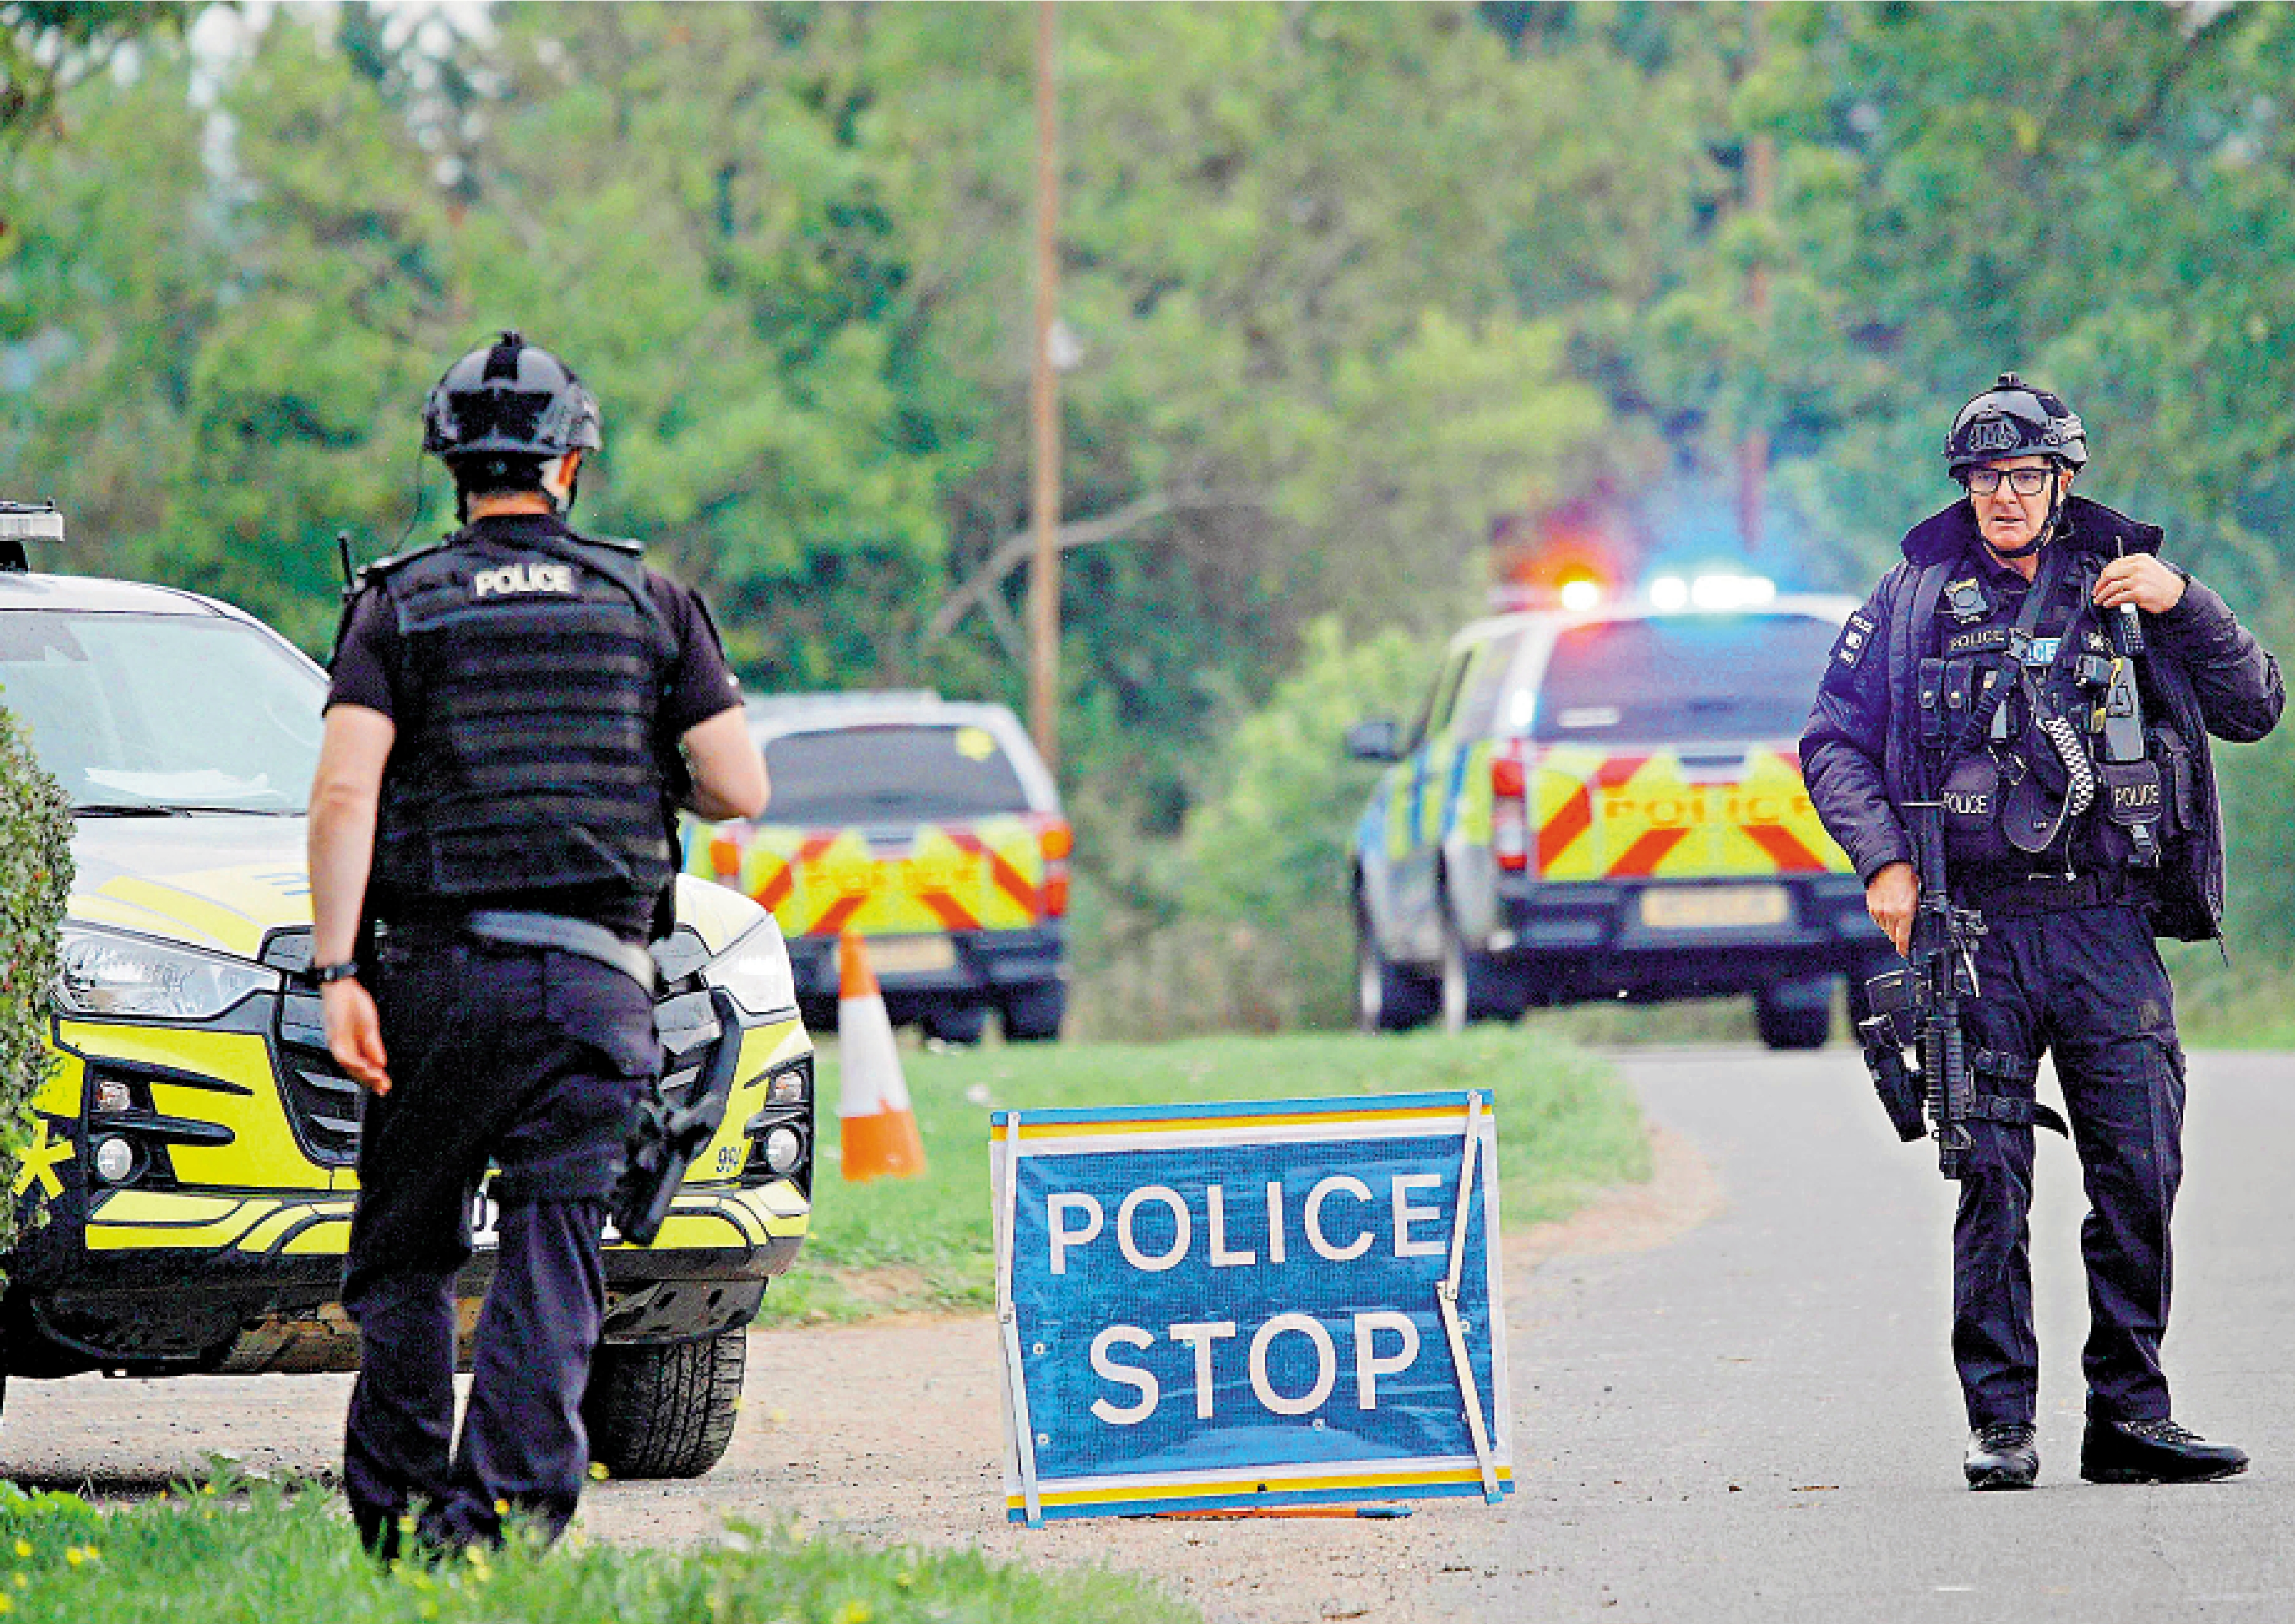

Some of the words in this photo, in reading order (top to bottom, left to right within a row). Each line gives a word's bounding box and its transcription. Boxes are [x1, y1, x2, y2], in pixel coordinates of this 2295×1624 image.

[475, 563, 574, 596] POLICE
[1951, 631, 2005, 650] POLICE
[2027, 642, 2059, 661] ICE
[1943, 792, 1989, 814] POLICE
[2115, 784, 2160, 807] POLICE
[1047, 1175, 1446, 1274] POLICE
[1090, 1312, 1420, 1425] STOP
